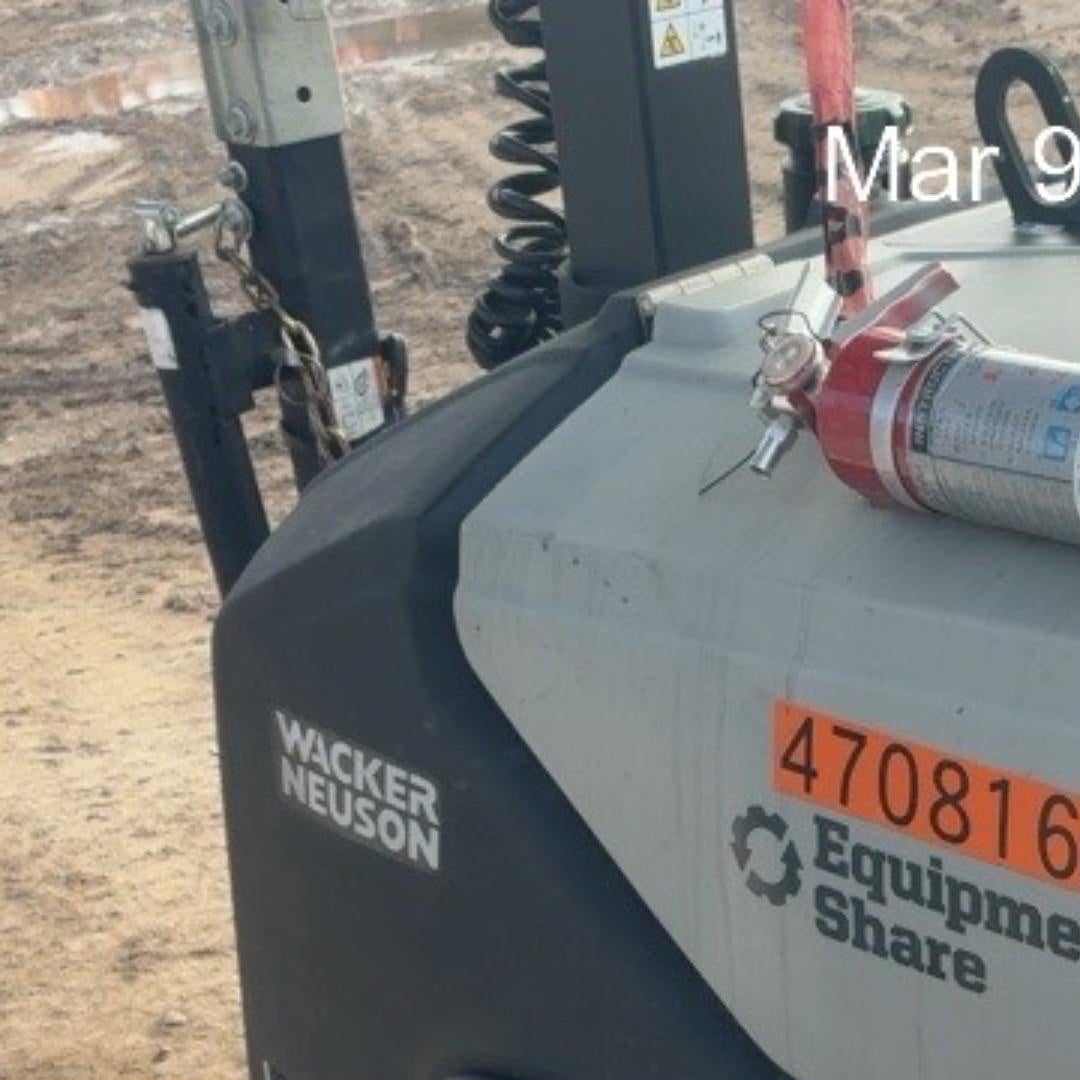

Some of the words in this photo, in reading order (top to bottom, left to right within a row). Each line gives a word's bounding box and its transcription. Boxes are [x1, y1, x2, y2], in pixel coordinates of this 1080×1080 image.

[274, 710, 440, 827] WACKER
[281, 755, 440, 871] NEUSON
[780, 716, 1080, 881] 470816
[814, 884, 988, 994] Share
